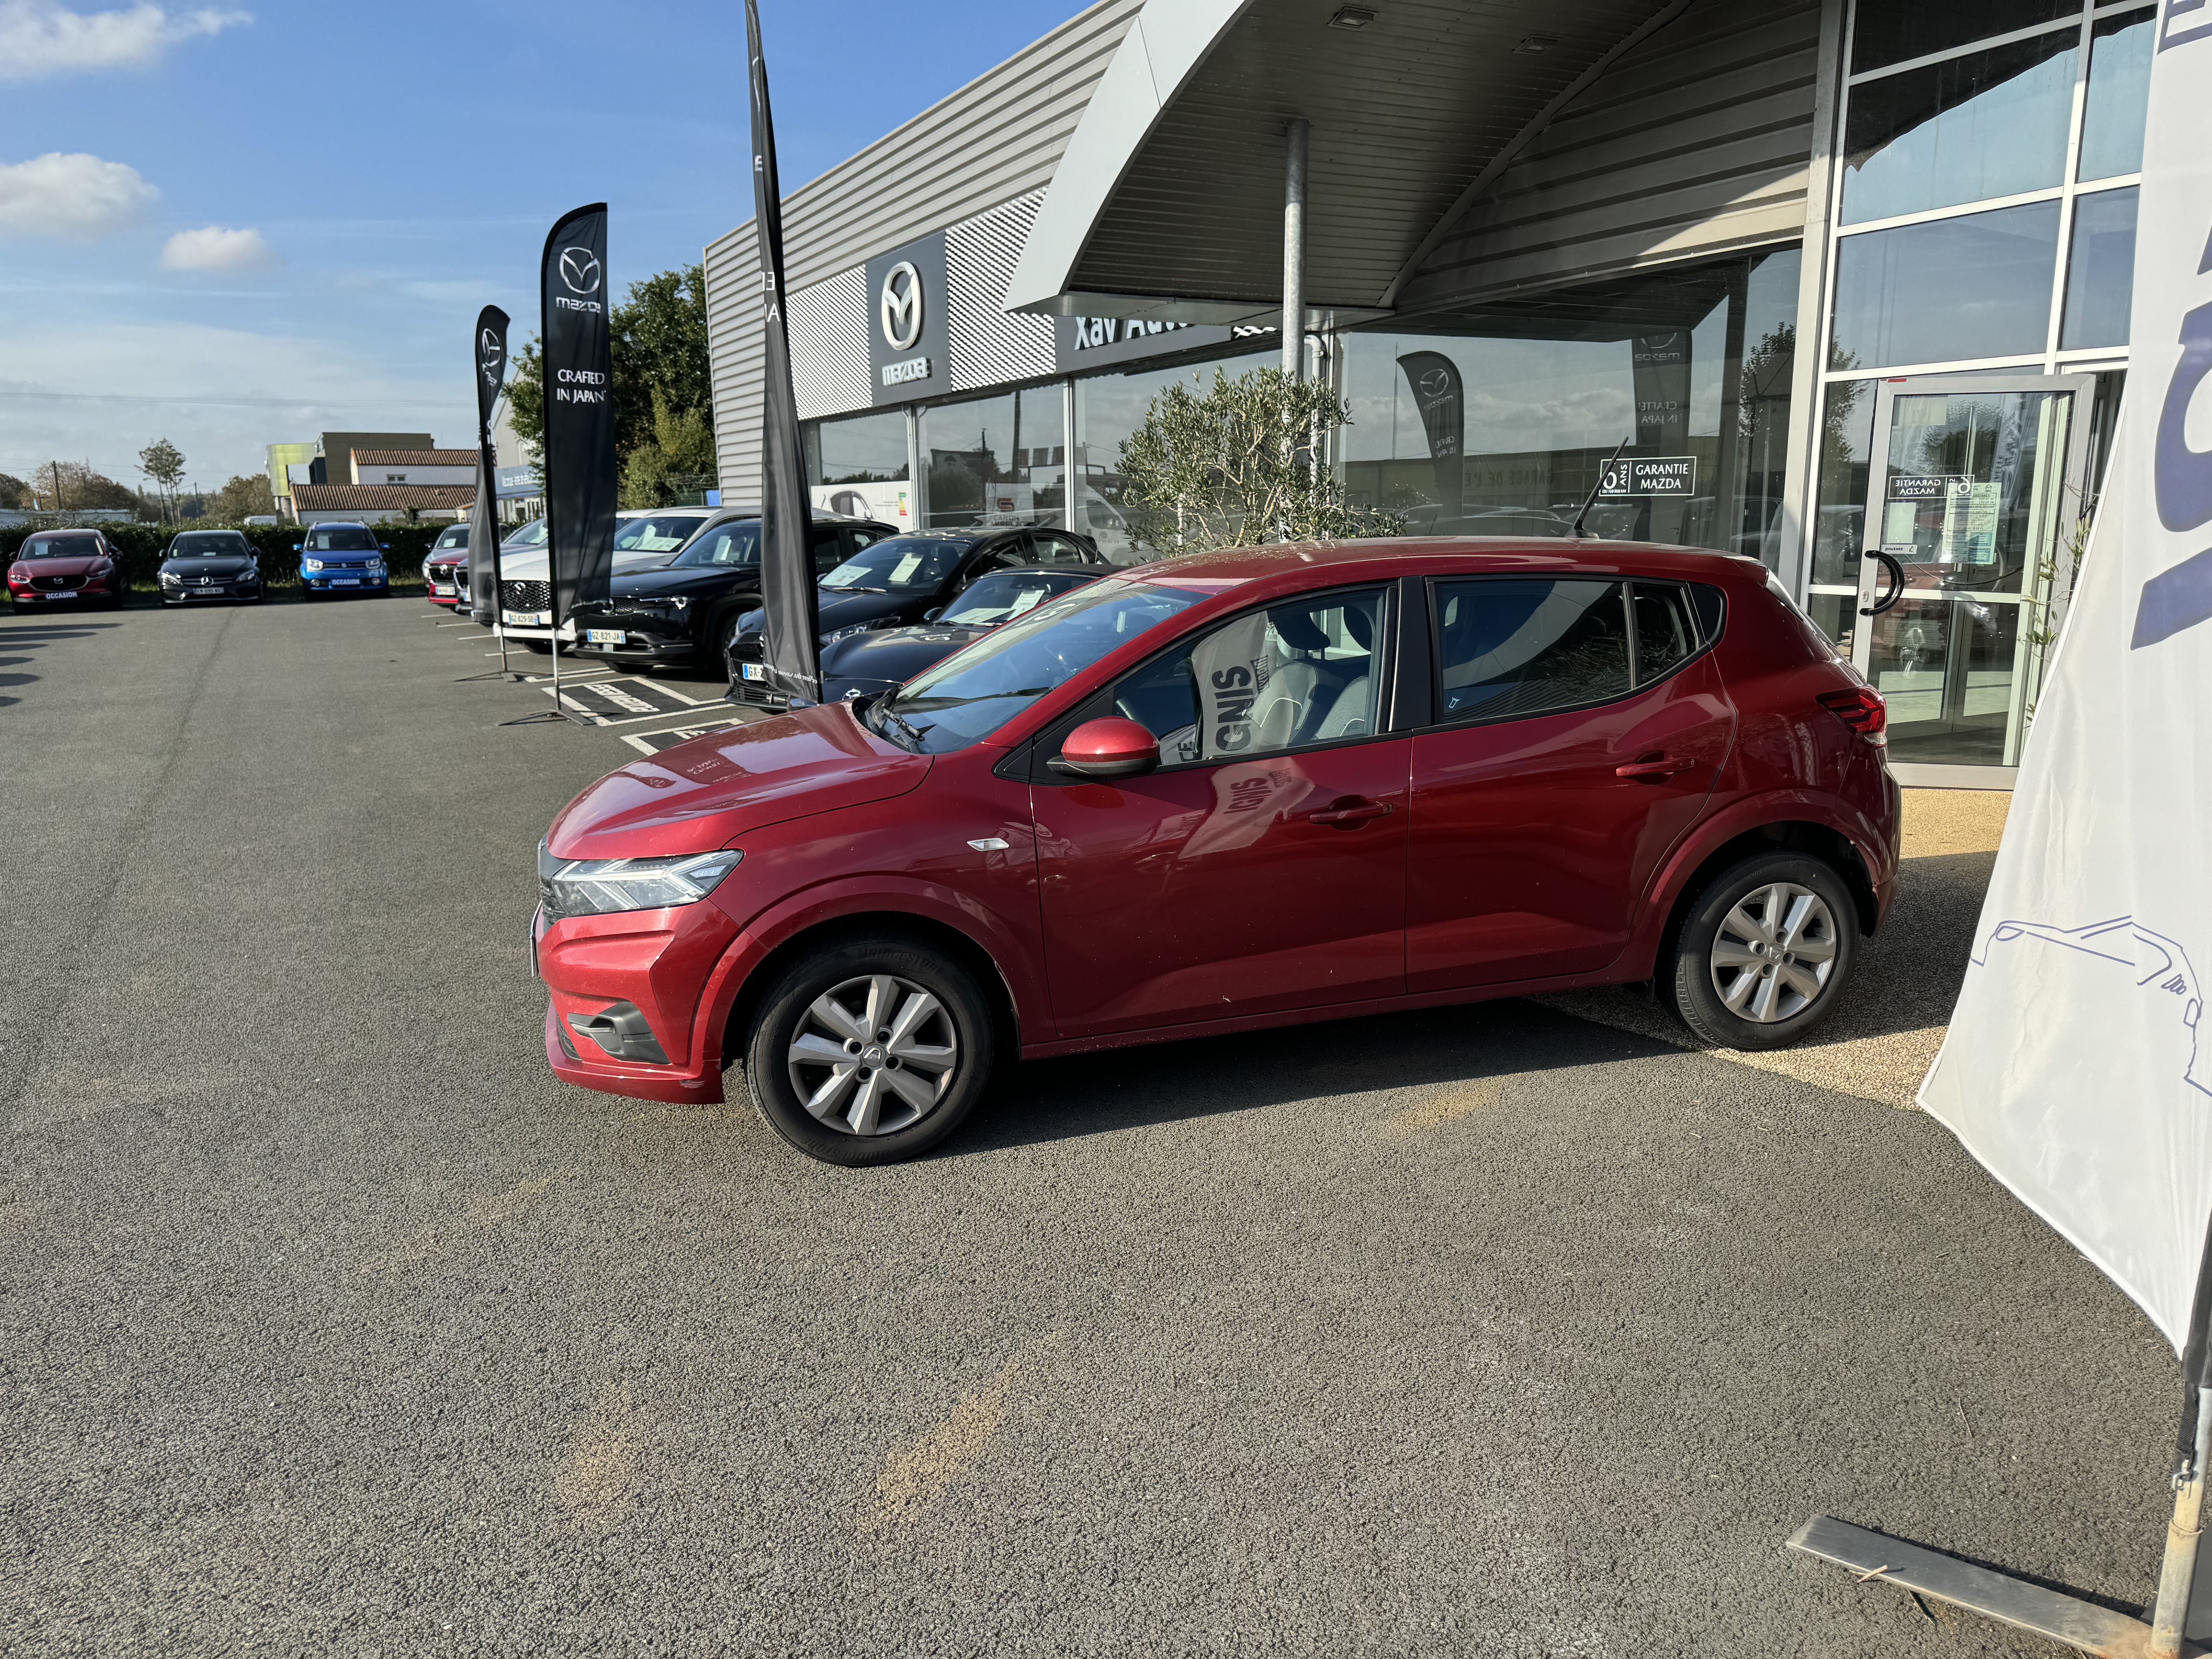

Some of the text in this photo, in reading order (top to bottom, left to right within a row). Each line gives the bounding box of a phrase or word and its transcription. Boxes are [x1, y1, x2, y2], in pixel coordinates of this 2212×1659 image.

[1075, 316, 1116, 350] Xav
[558, 369, 605, 385] CRAFTED
[882, 357, 927, 386] mazda
[557, 388, 605, 404] IN JAPAN
[1620, 464, 1628, 486] ANS
[1636, 464, 1688, 475] GARANTIE
[1640, 478, 1681, 489] MAZDA
